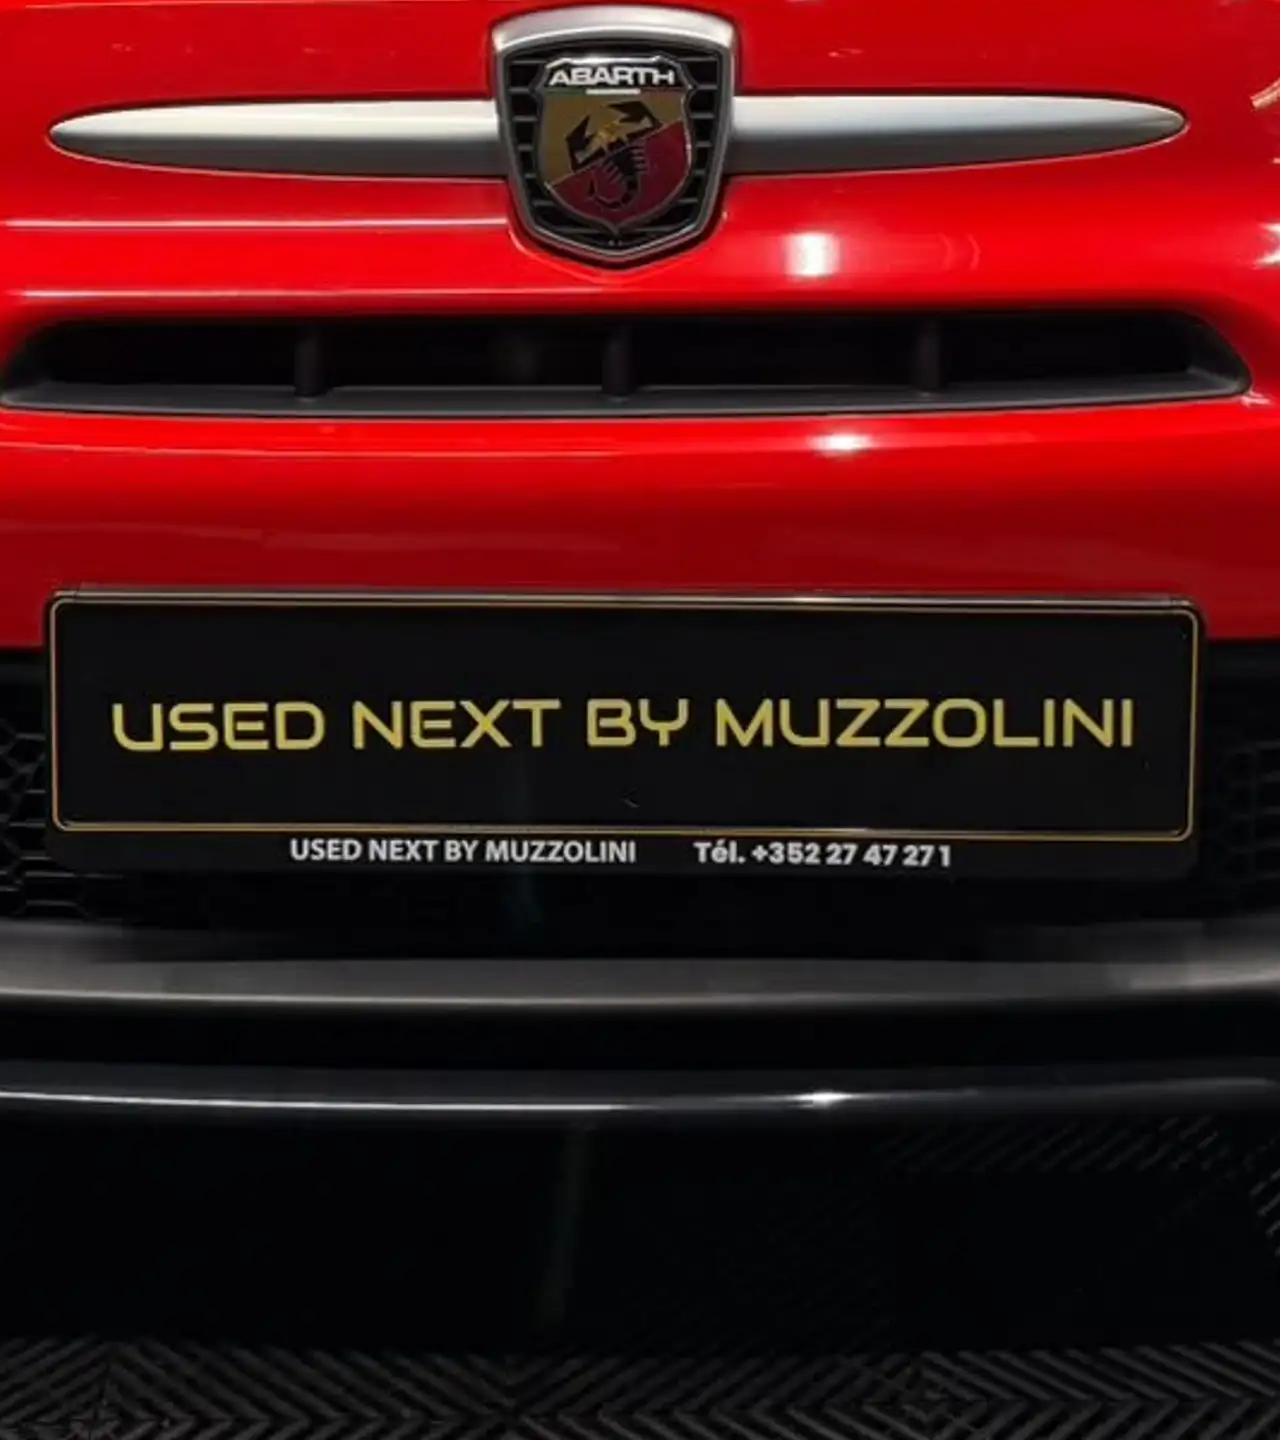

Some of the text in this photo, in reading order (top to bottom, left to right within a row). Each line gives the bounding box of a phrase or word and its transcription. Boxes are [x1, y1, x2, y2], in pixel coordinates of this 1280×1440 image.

[548, 65, 676, 87] ABARTH
[112, 697, 1134, 752] USED NEXT BY MUZZOLINI
[290, 837, 637, 864] USED NEXT BY MUZZOLINI
[693, 839, 747, 864] Tél.
[751, 841, 822, 865] +352
[826, 842, 858, 866] 27
[863, 843, 898, 867] 47
